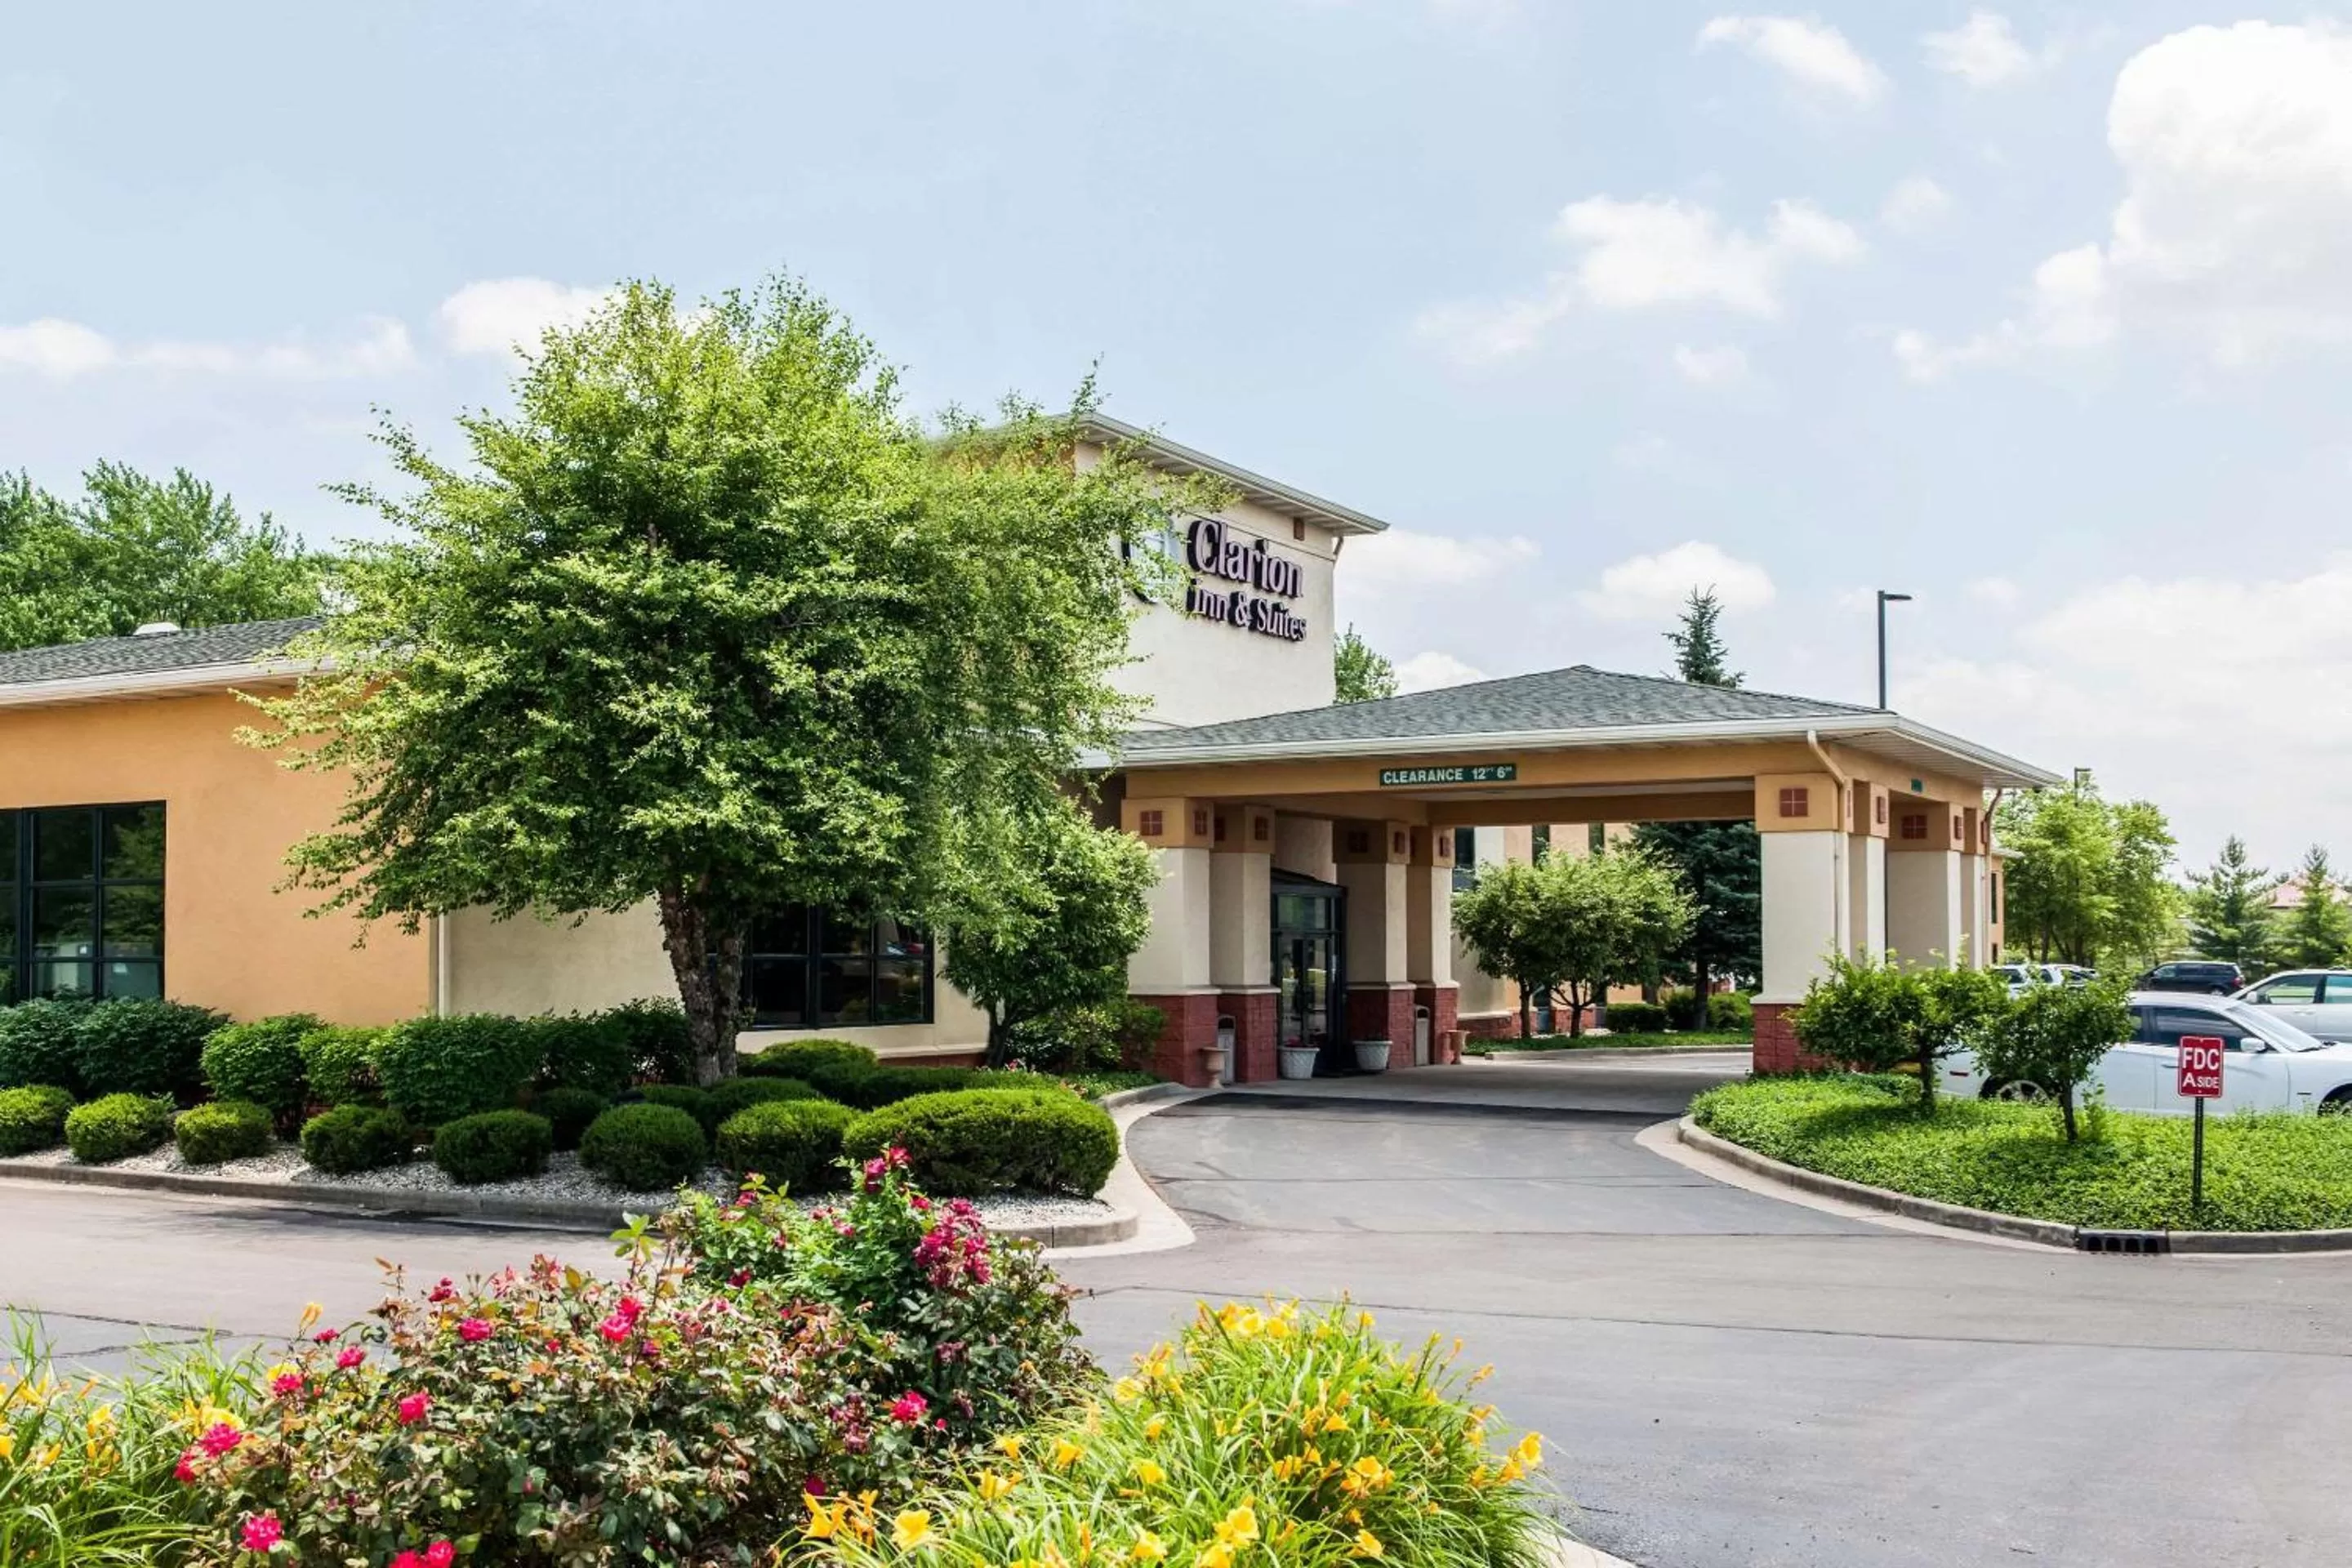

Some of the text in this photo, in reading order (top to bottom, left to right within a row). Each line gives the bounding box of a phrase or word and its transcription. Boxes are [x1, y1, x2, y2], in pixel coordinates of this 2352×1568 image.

[1187, 520, 1304, 599] Clarion
[1227, 590, 1250, 627] &
[1250, 597, 1307, 642] Suites
[1383, 768, 1463, 784] CLEARANCE
[2182, 1047, 2220, 1070] FDC
